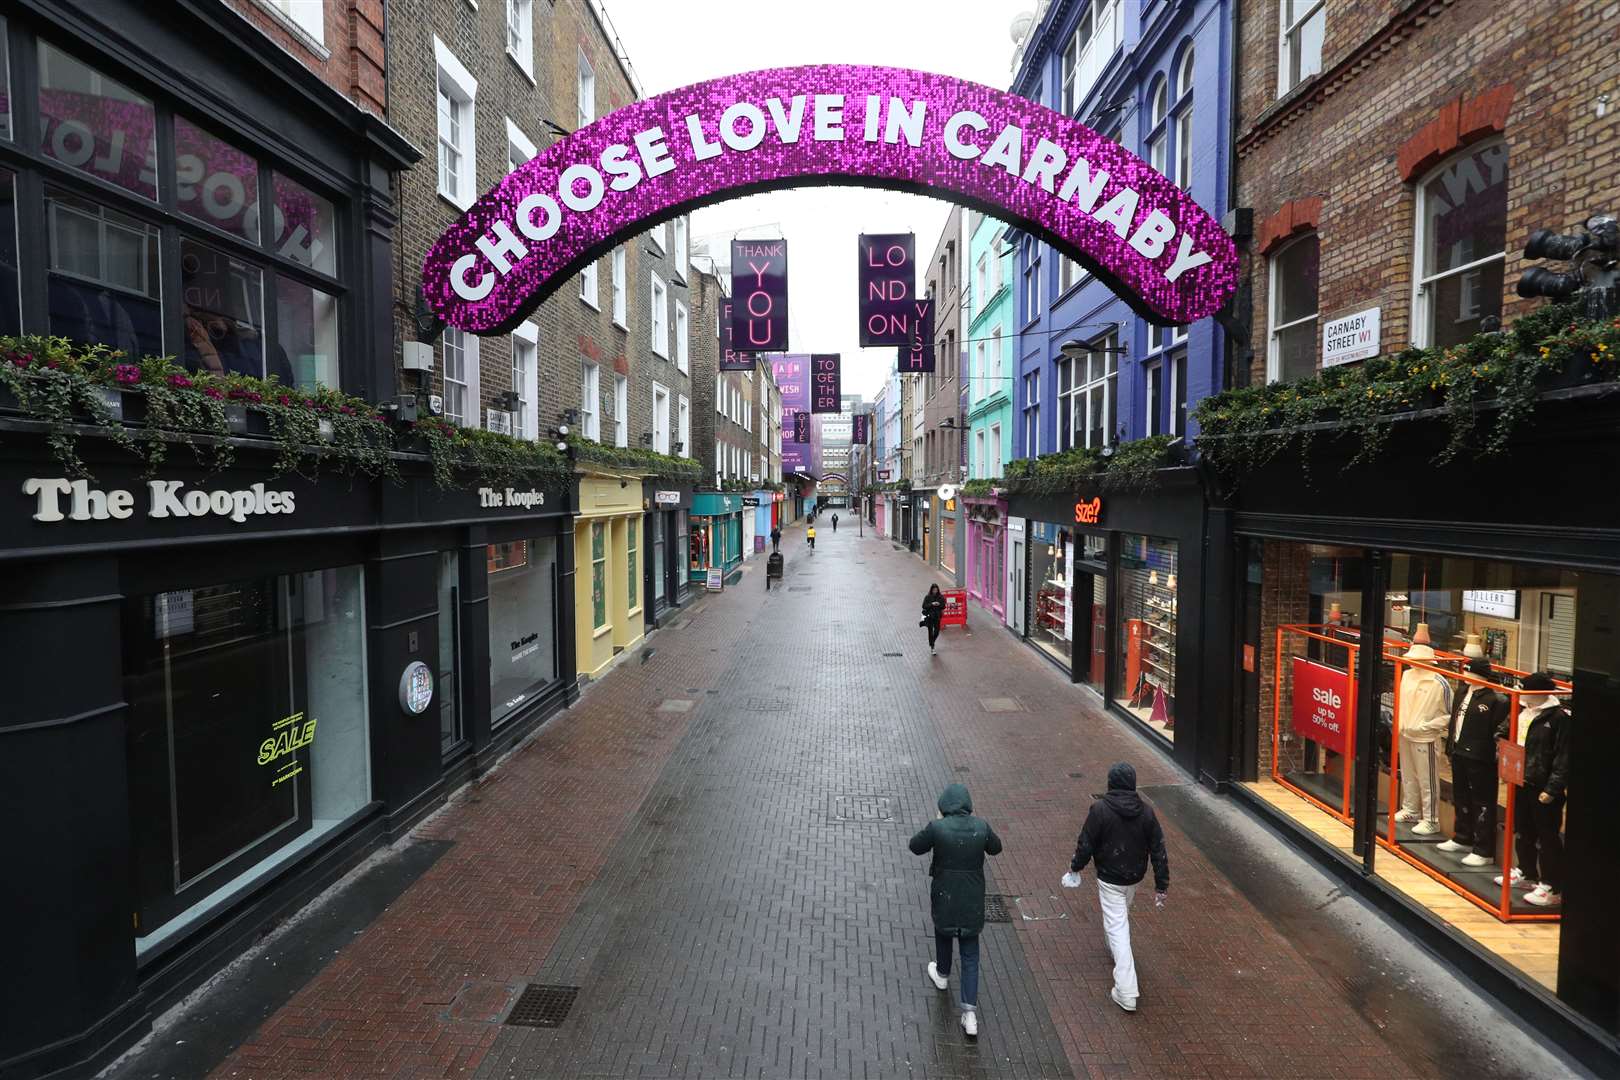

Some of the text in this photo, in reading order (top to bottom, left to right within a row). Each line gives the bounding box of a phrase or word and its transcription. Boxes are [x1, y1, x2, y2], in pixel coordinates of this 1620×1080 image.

[450, 94, 1213, 301] CHOOSE LOVE IN CARNABY
[736, 245, 783, 257] THANK
[748, 262, 772, 345] YOU
[1327, 315, 1367, 338] CARNABY
[1327, 330, 1371, 352] STREET W1
[23, 478, 295, 522] The Kooples
[478, 487, 544, 510] The Kooples
[1075, 497, 1101, 523] size?
[1312, 687, 1342, 709] sale
[1312, 713, 1328, 728] 50%
[1317, 707, 1336, 720] up to
[257, 718, 318, 765] SALE
